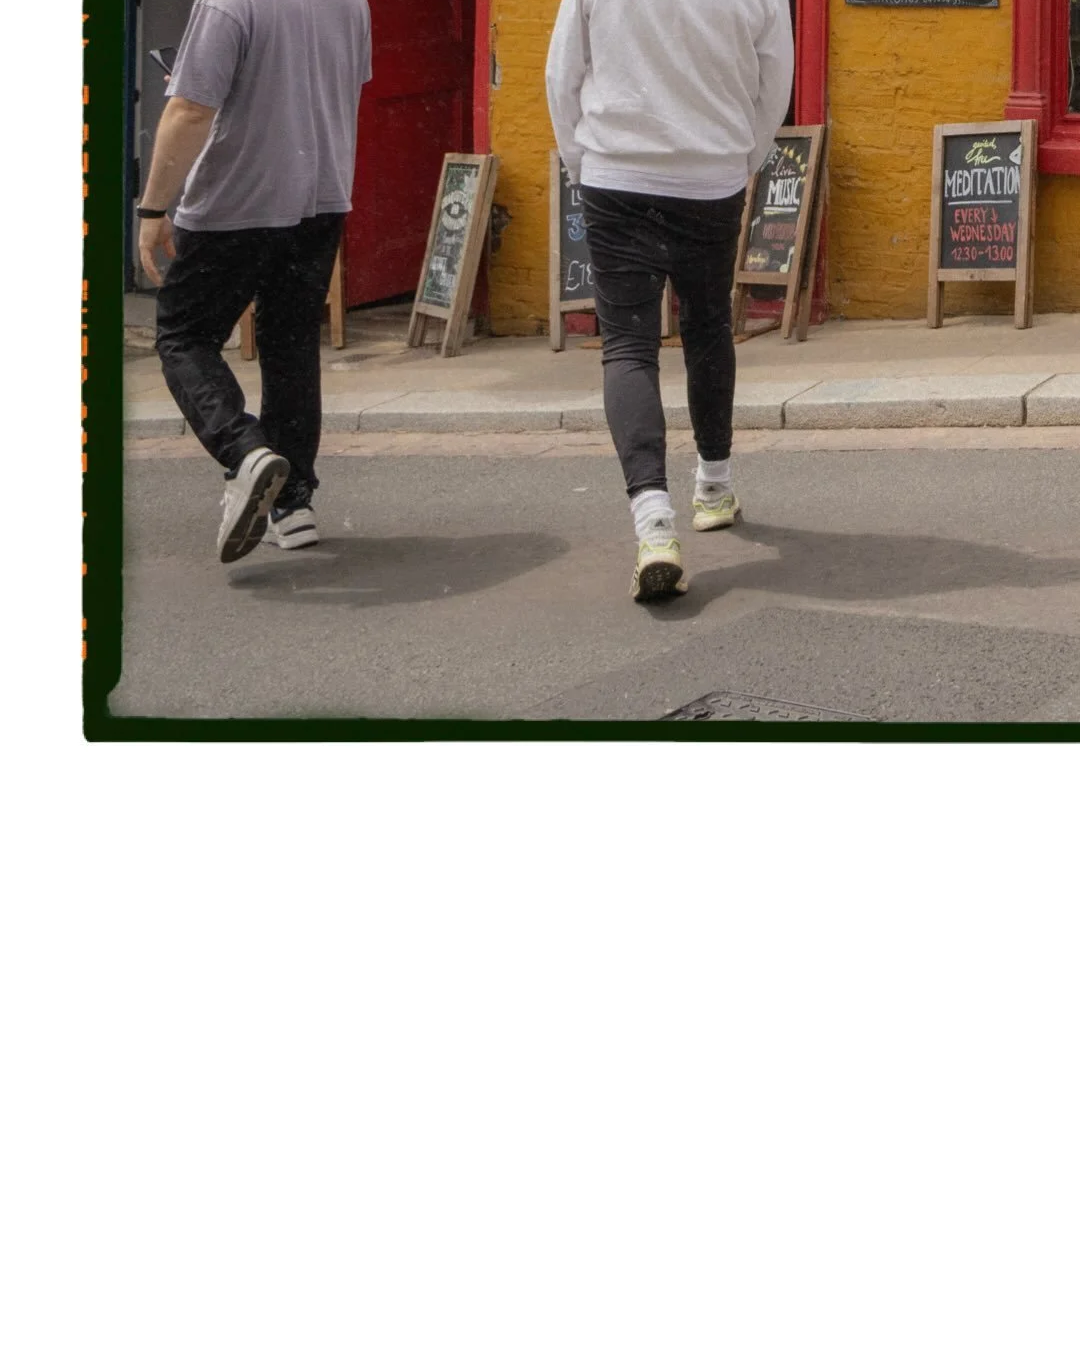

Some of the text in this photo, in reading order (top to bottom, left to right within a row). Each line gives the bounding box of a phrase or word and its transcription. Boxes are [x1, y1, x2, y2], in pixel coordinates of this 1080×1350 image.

[765, 177, 800, 206] MUSIC
[944, 166, 1020, 198] MEDITATION
[954, 207, 988, 224] EVERY
[950, 222, 1017, 243] WEDNESDAY
